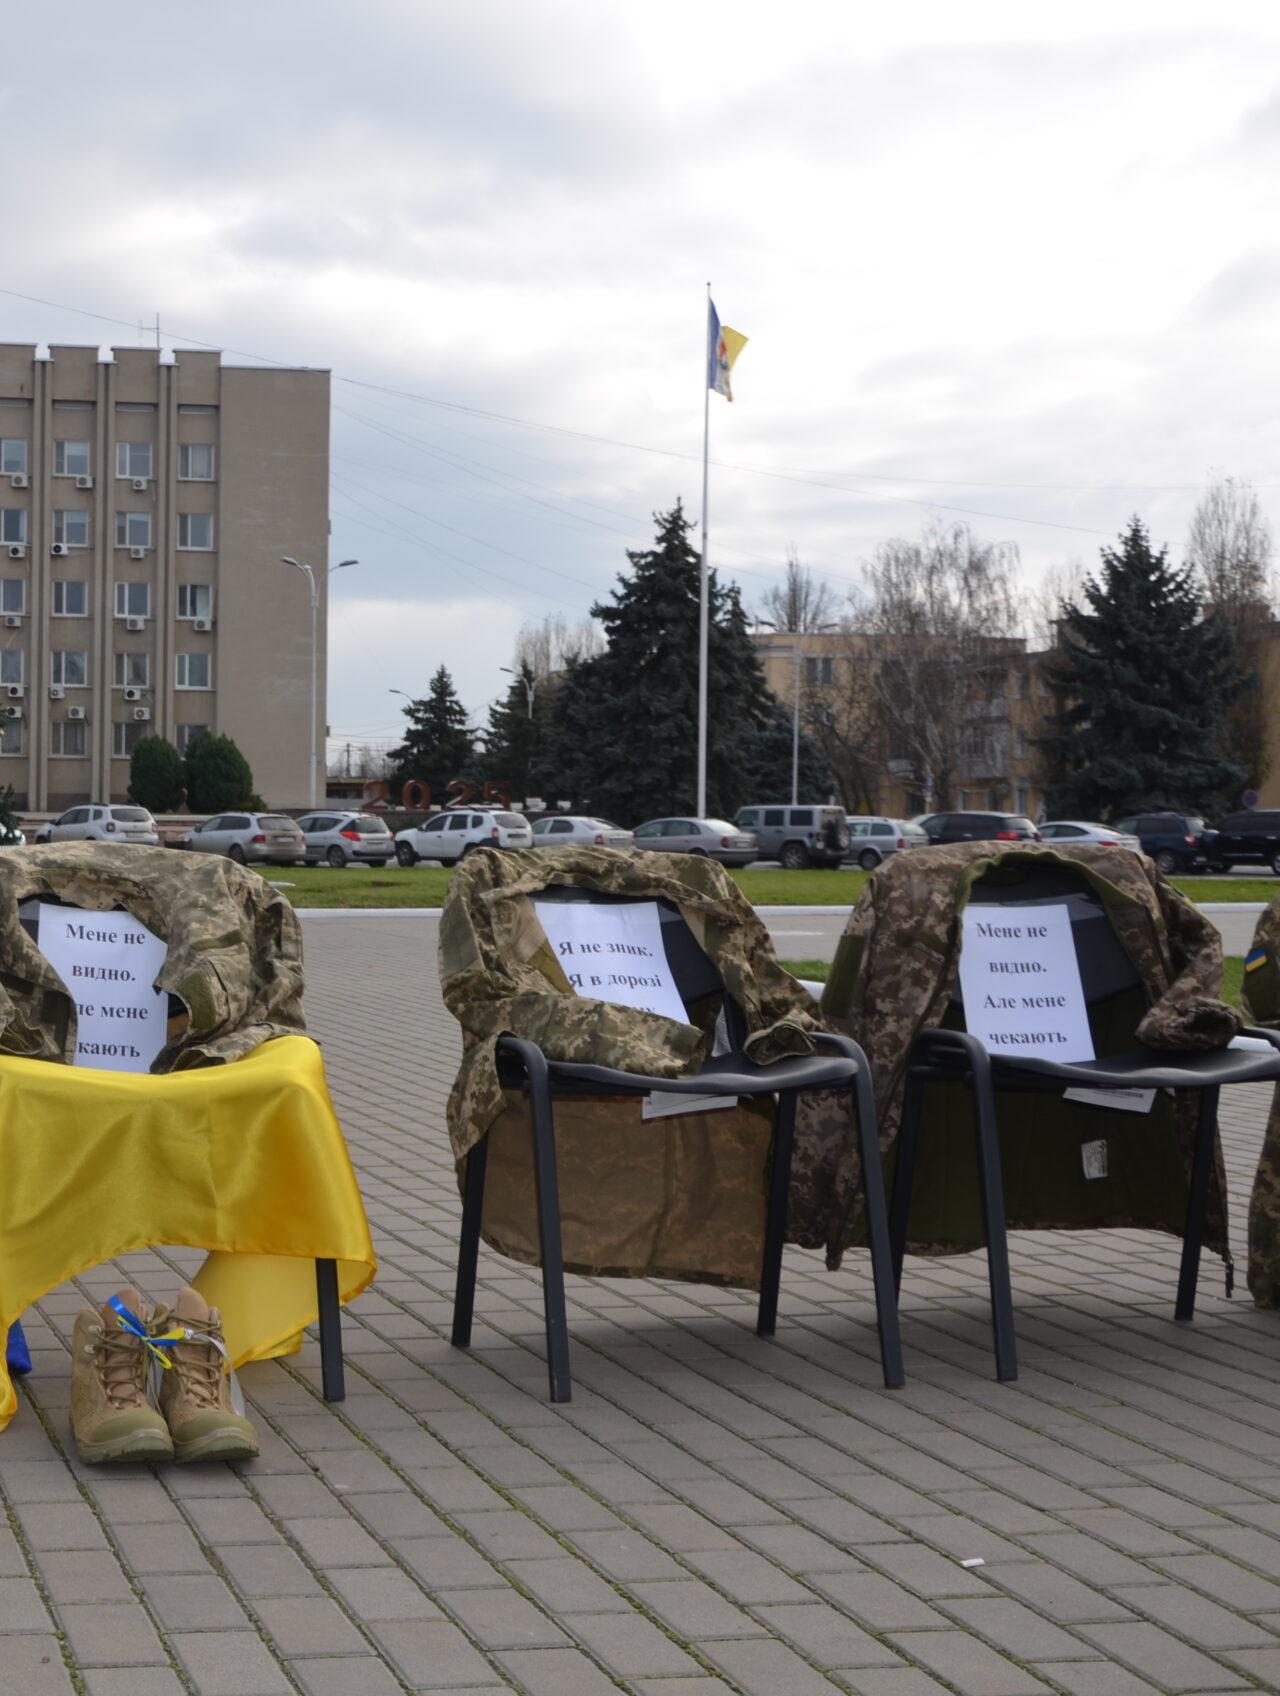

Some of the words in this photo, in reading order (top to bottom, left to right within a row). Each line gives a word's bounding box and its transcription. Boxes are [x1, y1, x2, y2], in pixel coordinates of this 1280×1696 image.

[362, 780, 511, 812] 2025
[66, 923, 118, 944] Мене
[124, 932, 146, 944] не
[976, 922, 1021, 938] Мене
[1026, 926, 1048, 938] не
[559, 941, 572, 956] Я
[580, 943, 601, 954] не
[608, 943, 654, 957] зник.
[72, 965, 136, 982] видно.
[989, 961, 1048, 975] видно.
[569, 973, 583, 988] Я
[590, 976, 602, 987] в
[608, 974, 662, 990] дорозі
[983, 994, 1017, 1009] Але
[1022, 995, 1067, 1009] мене
[100, 1005, 148, 1020] мене
[988, 1031, 1068, 1045] чекають
[78, 1041, 141, 1058] кають
